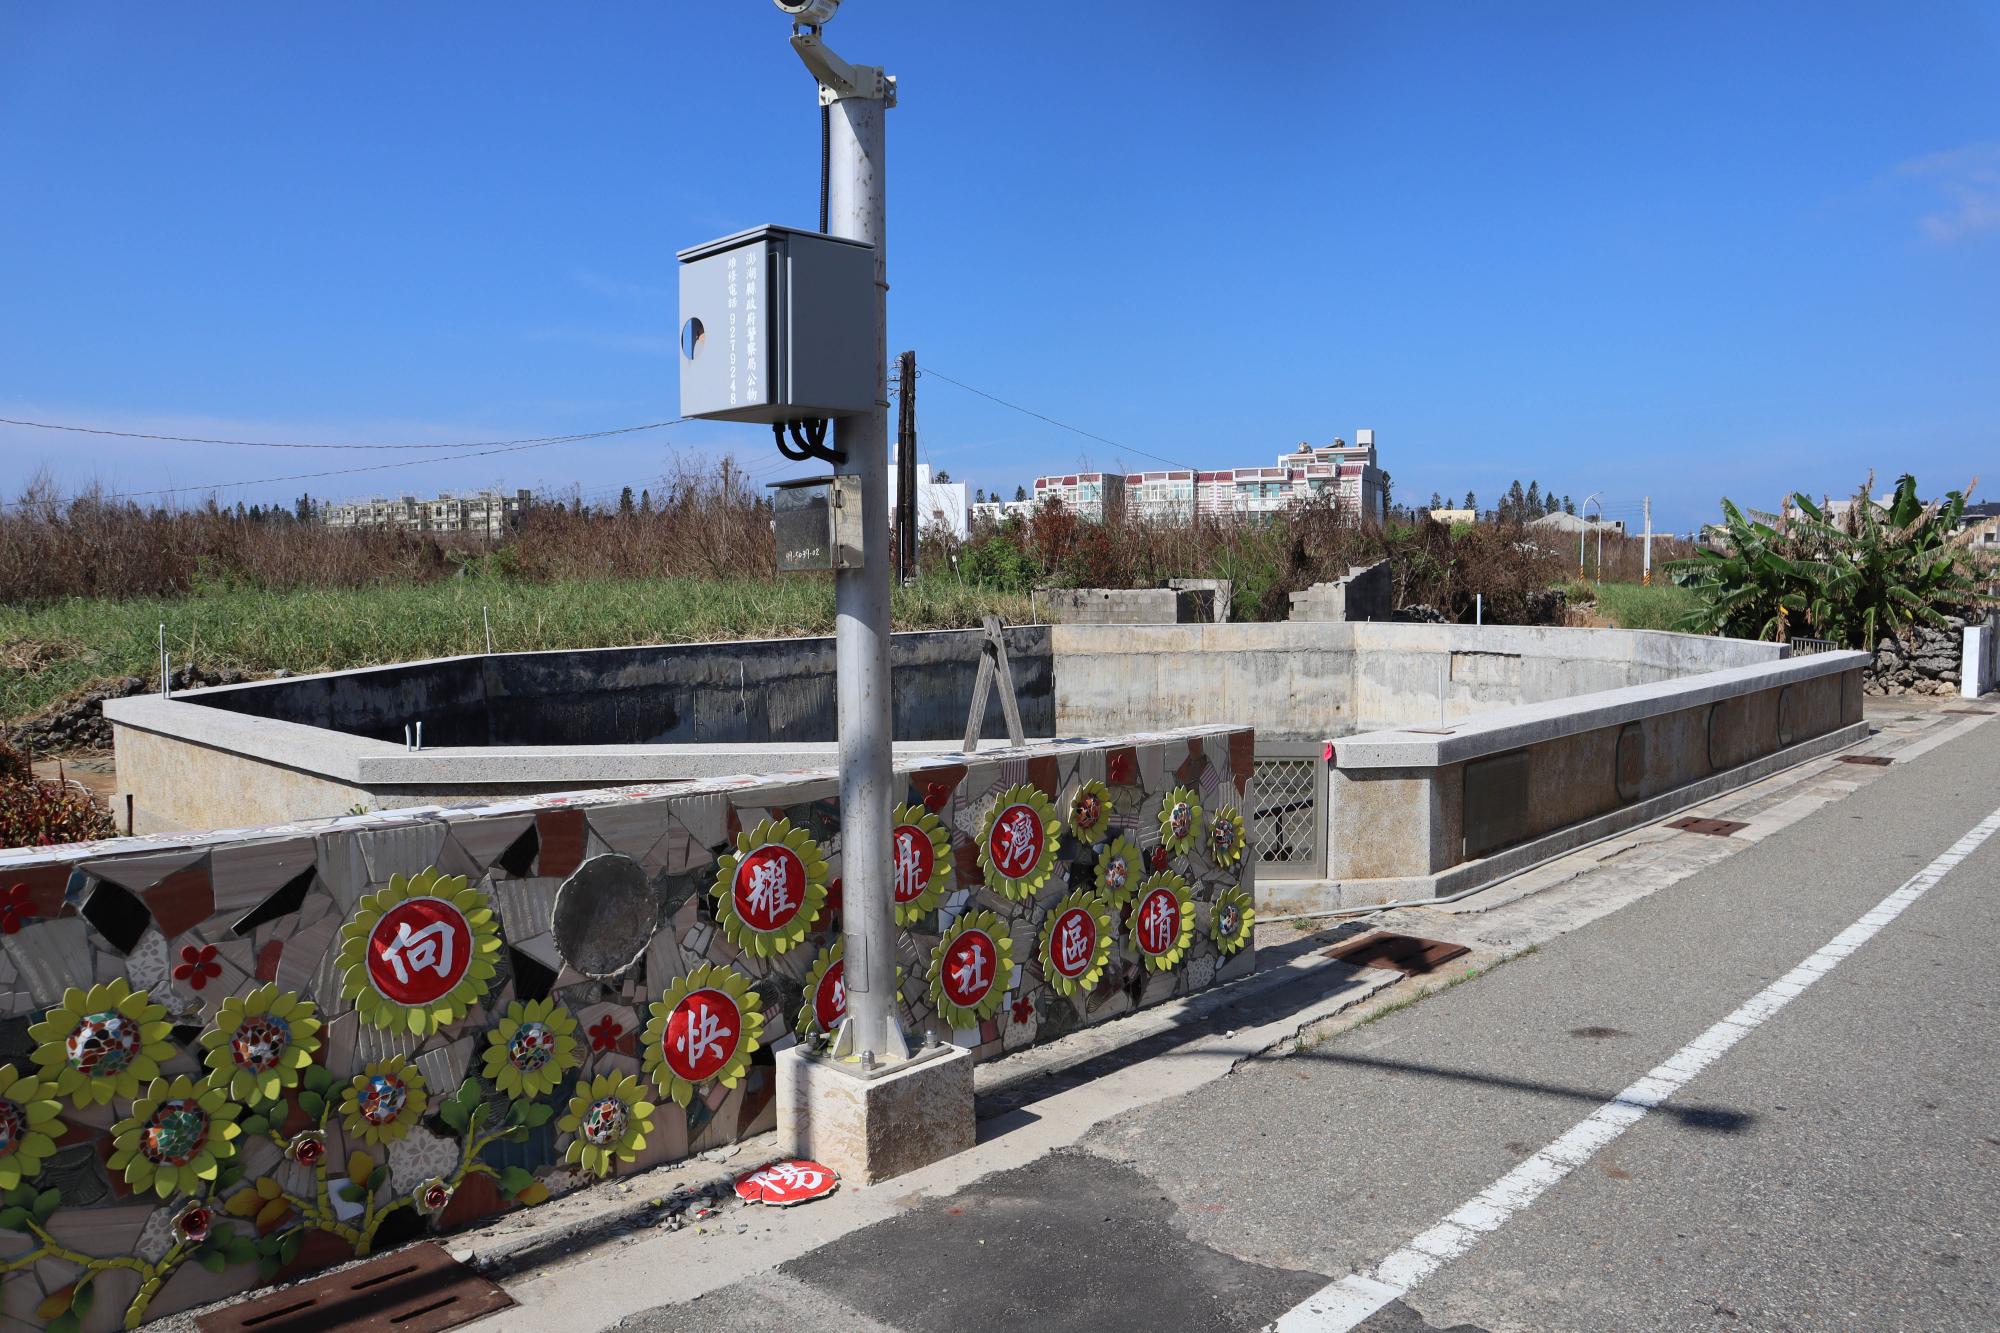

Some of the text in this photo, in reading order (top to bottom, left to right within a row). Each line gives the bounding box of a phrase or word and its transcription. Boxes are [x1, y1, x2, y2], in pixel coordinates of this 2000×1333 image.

[382, 921, 455, 983] 向
[747, 856, 794, 922] 耀
[1002, 811, 1034, 870] 灣
[677, 896, 1176, 1068] 快 社 區 情
